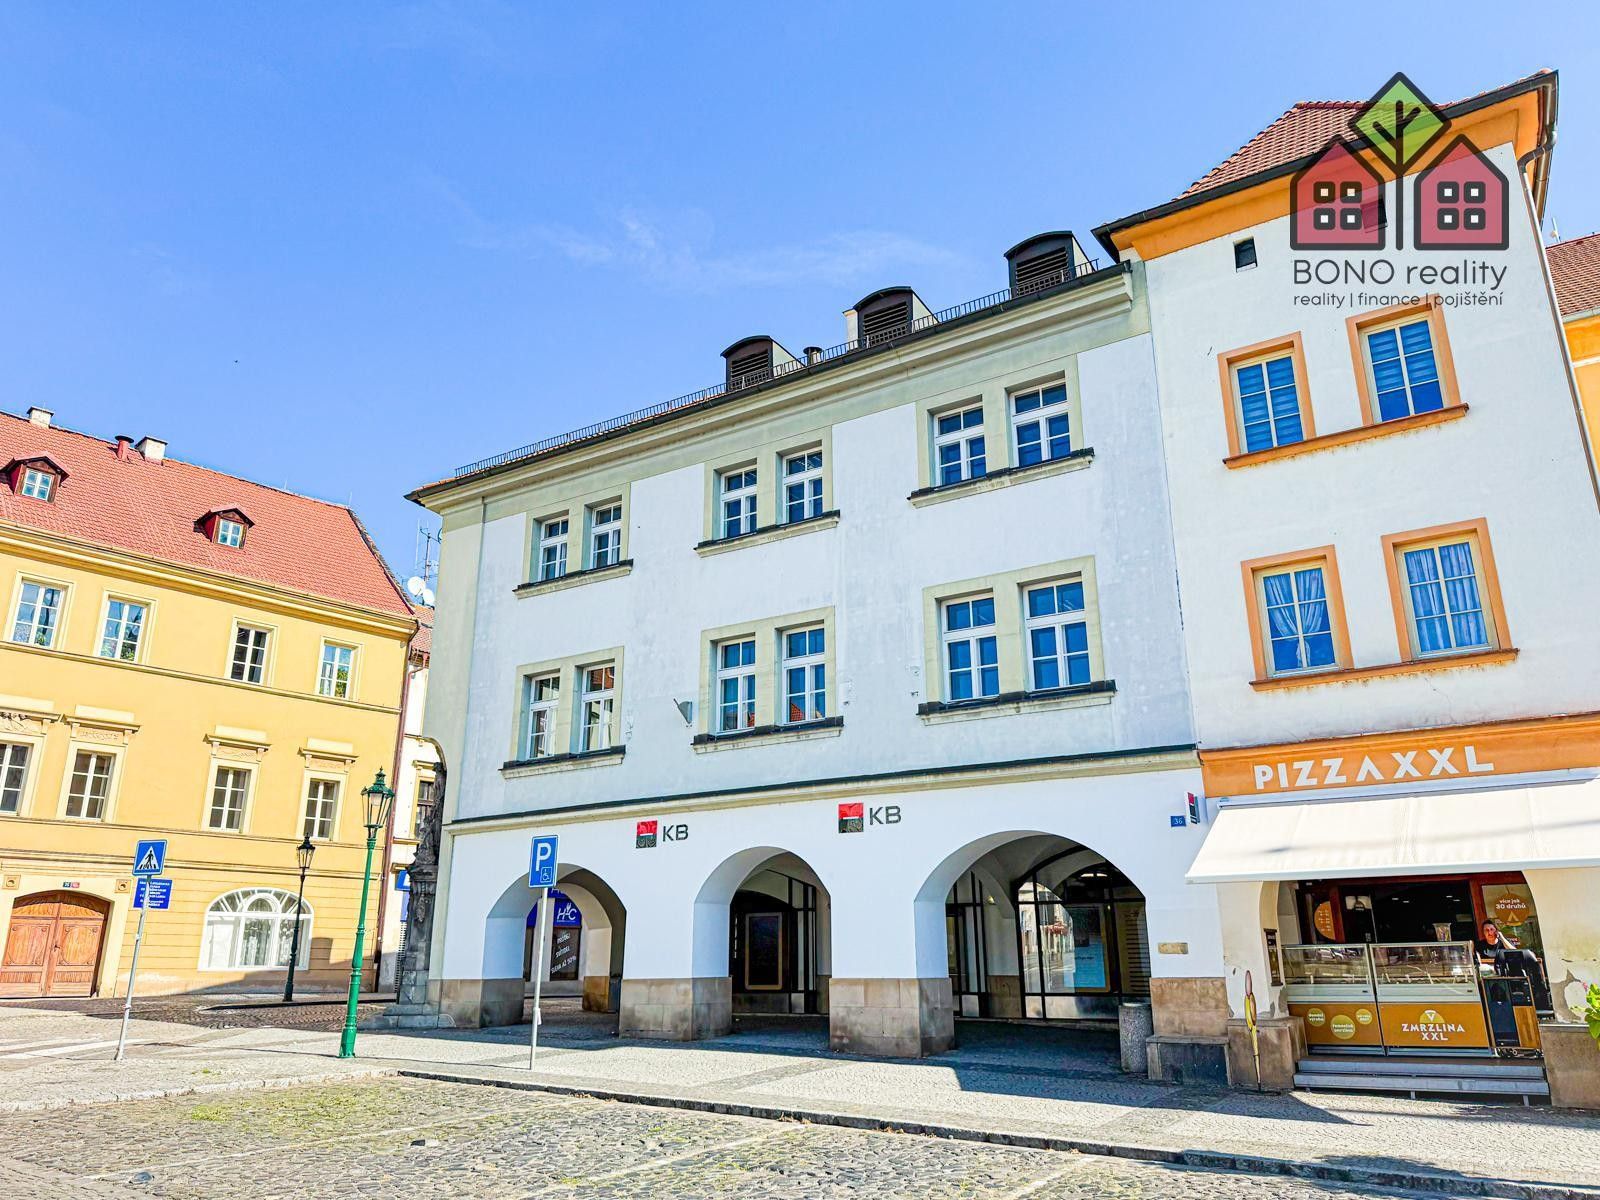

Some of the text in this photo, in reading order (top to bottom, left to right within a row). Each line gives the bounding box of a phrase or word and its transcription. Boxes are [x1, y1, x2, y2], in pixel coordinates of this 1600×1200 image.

[868, 805, 902, 826] KB
[662, 823, 689, 842] KB
[535, 842, 552, 872] P
[1401, 1023, 1465, 1033] ZMRZLINA
[1421, 1032, 1448, 1041] XXL
